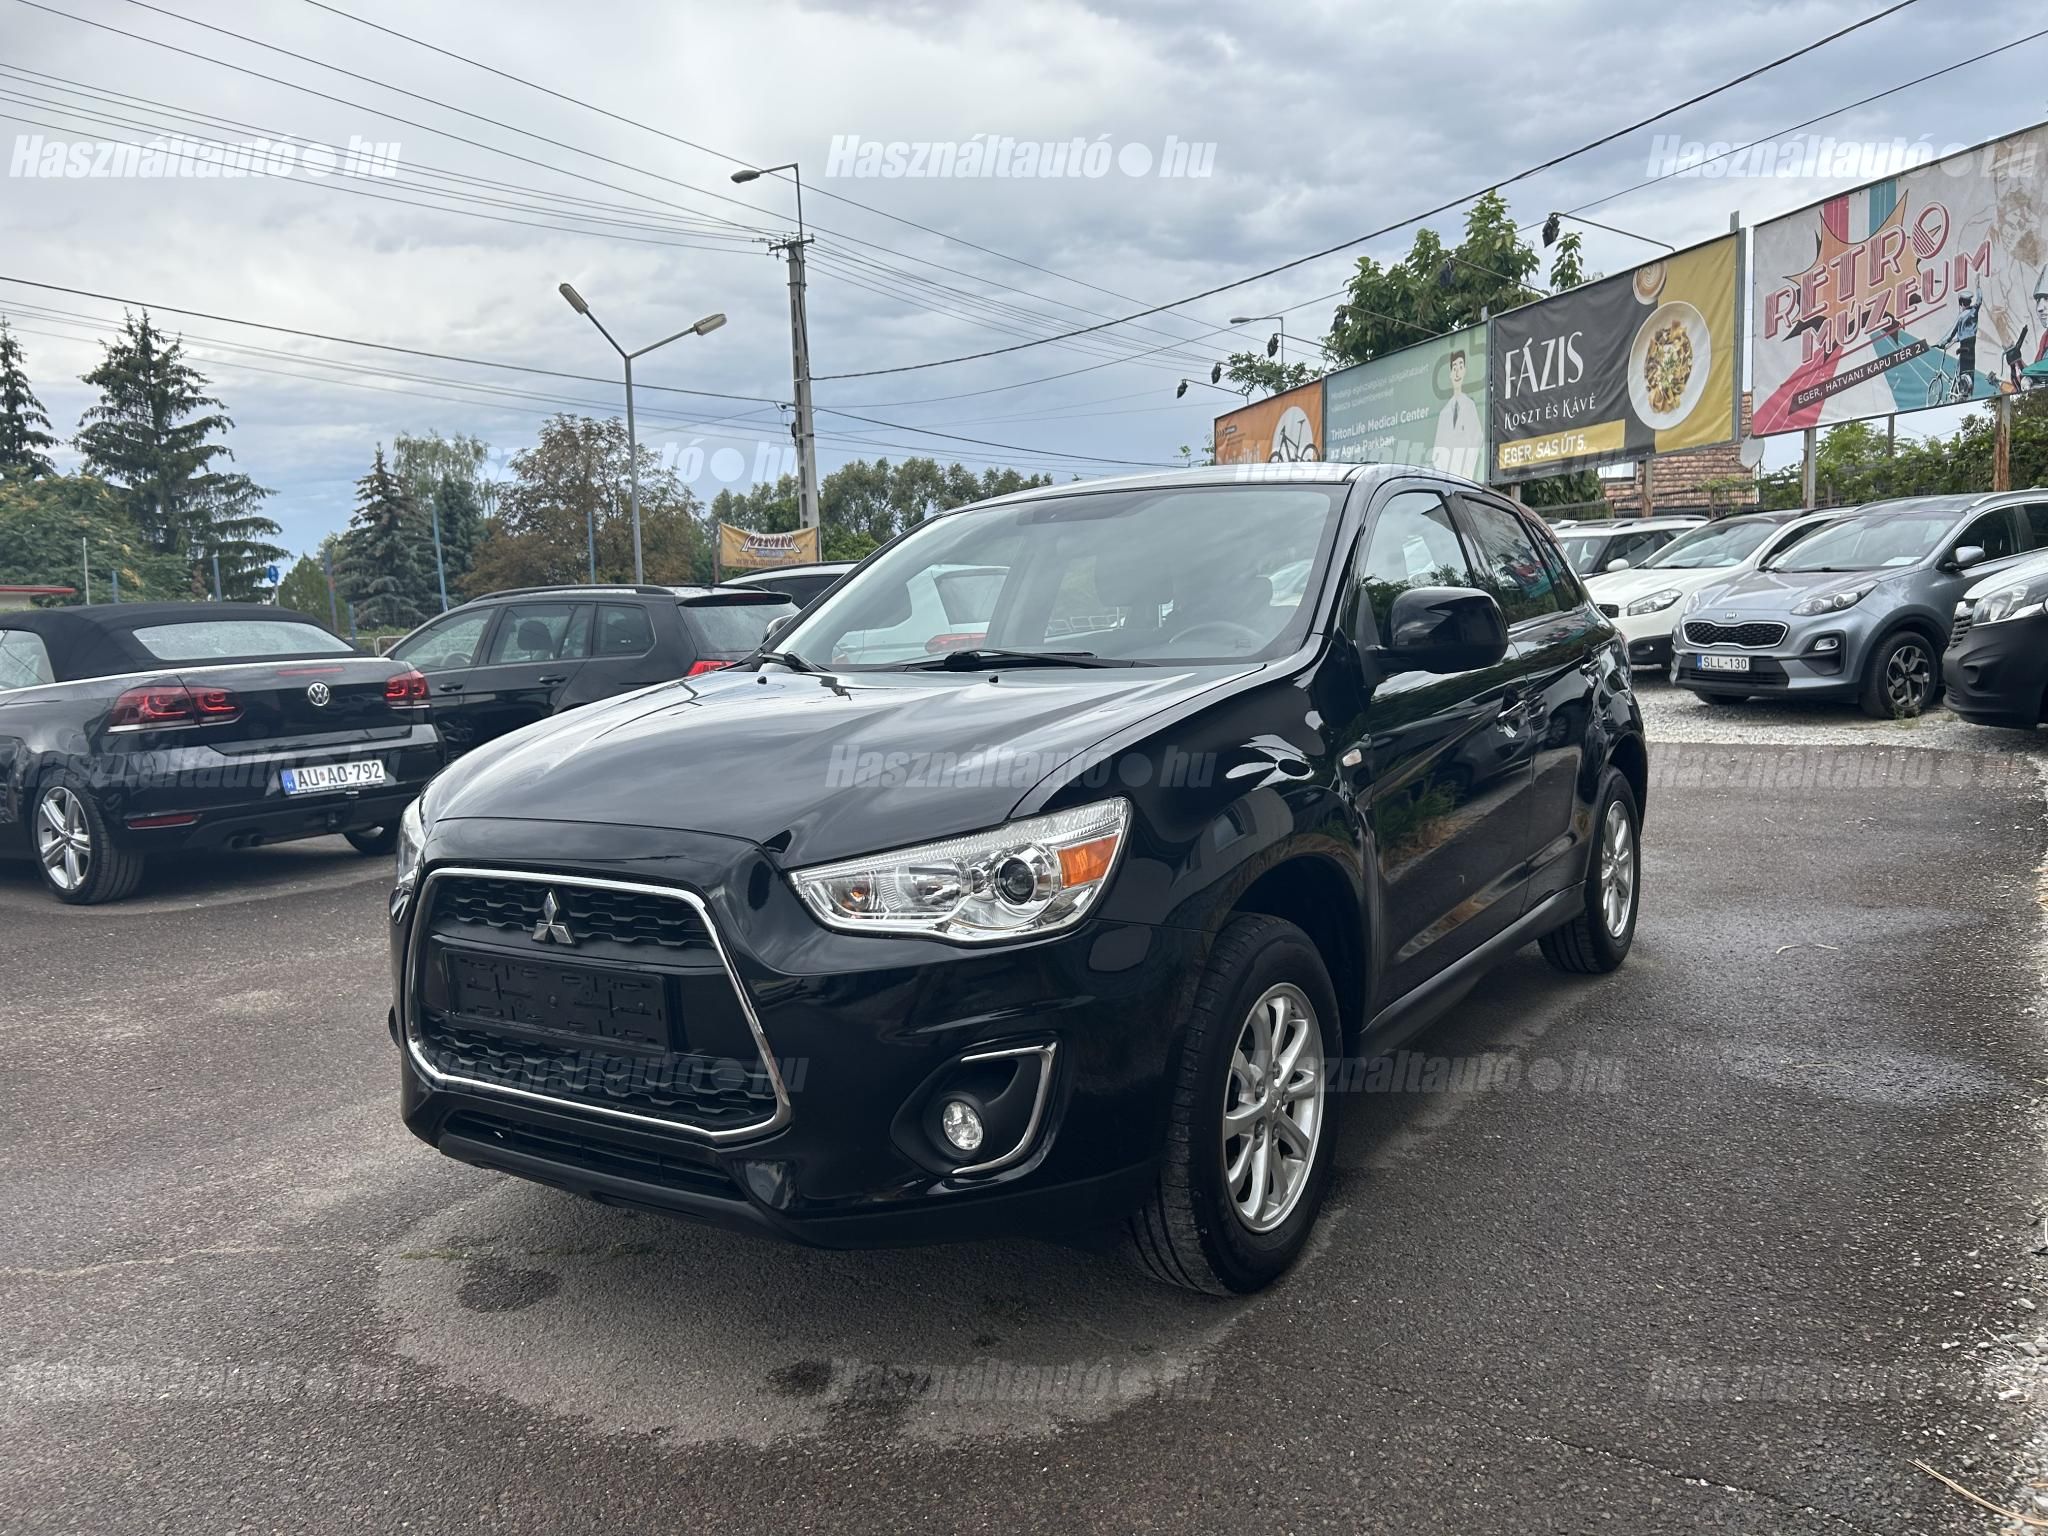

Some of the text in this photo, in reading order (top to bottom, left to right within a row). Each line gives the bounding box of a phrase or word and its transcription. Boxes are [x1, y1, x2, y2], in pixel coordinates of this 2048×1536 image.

[1764, 201, 1950, 339] RETRO
[1505, 331, 1584, 399] FÁZIS
[1798, 388, 1823, 404] EGER,
[1825, 369, 1864, 392] HATVANI
[1867, 358, 1891, 375] KAPU
[1331, 407, 1429, 441] TritonLife Medical Center
[1504, 392, 1597, 431] KOSZT ÉS KÁVÉ
[1341, 443, 1362, 458] Agria
[1503, 445, 1534, 465] EGER,
[1536, 439, 1560, 458] SAS
[1561, 432, 1577, 454] ÚT
[1703, 656, 1747, 669] SLL-130
